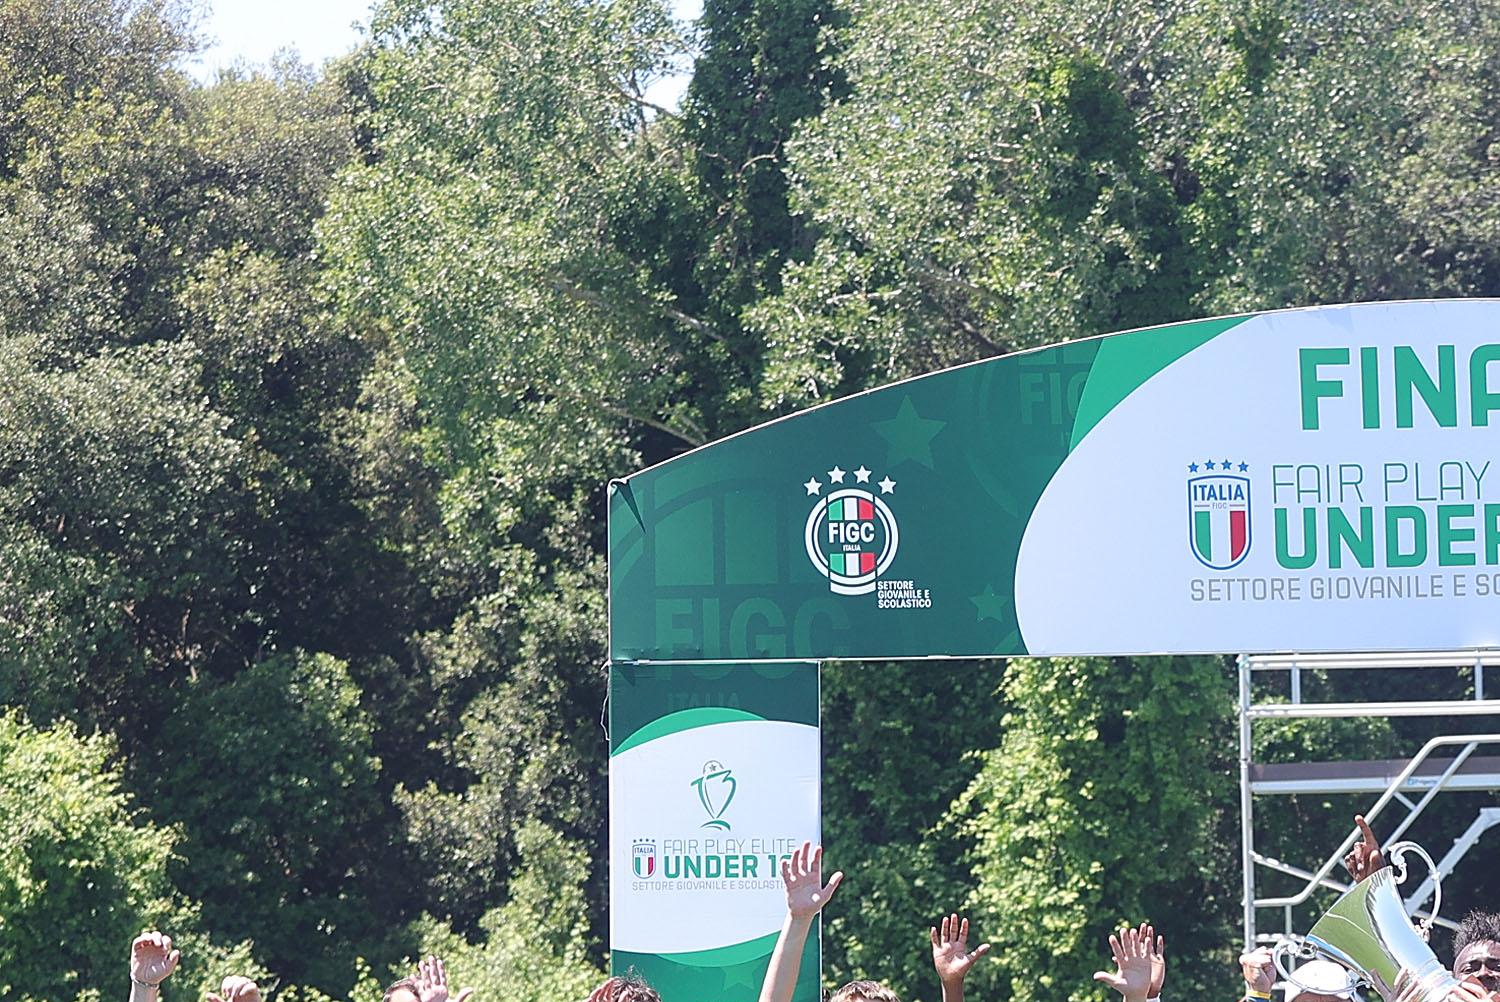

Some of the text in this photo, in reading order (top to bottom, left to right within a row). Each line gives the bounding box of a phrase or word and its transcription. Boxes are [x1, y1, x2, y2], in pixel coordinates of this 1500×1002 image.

[1272, 462, 1365, 504] FAIR
[1384, 460, 1491, 502] PLAY
[1193, 484, 1245, 502] ITALIA
[828, 521, 874, 543] FIGC
[877, 580, 914, 590] SETTORE
[1190, 577, 1301, 602] SETTORE
[1310, 575, 1444, 600] GIOVANILE
[1453, 574, 1467, 597] E
[877, 589, 930, 600] GIOVANILE E
[877, 598, 932, 609] SCOLASTICO
[663, 838, 797, 855] FAIR PLAY ELITE
[663, 854, 792, 879] UNDER 1
[632, 881, 674, 891] SETTORE
[676, 880, 728, 891] GIOVANILE
[729, 880, 737, 890] E
